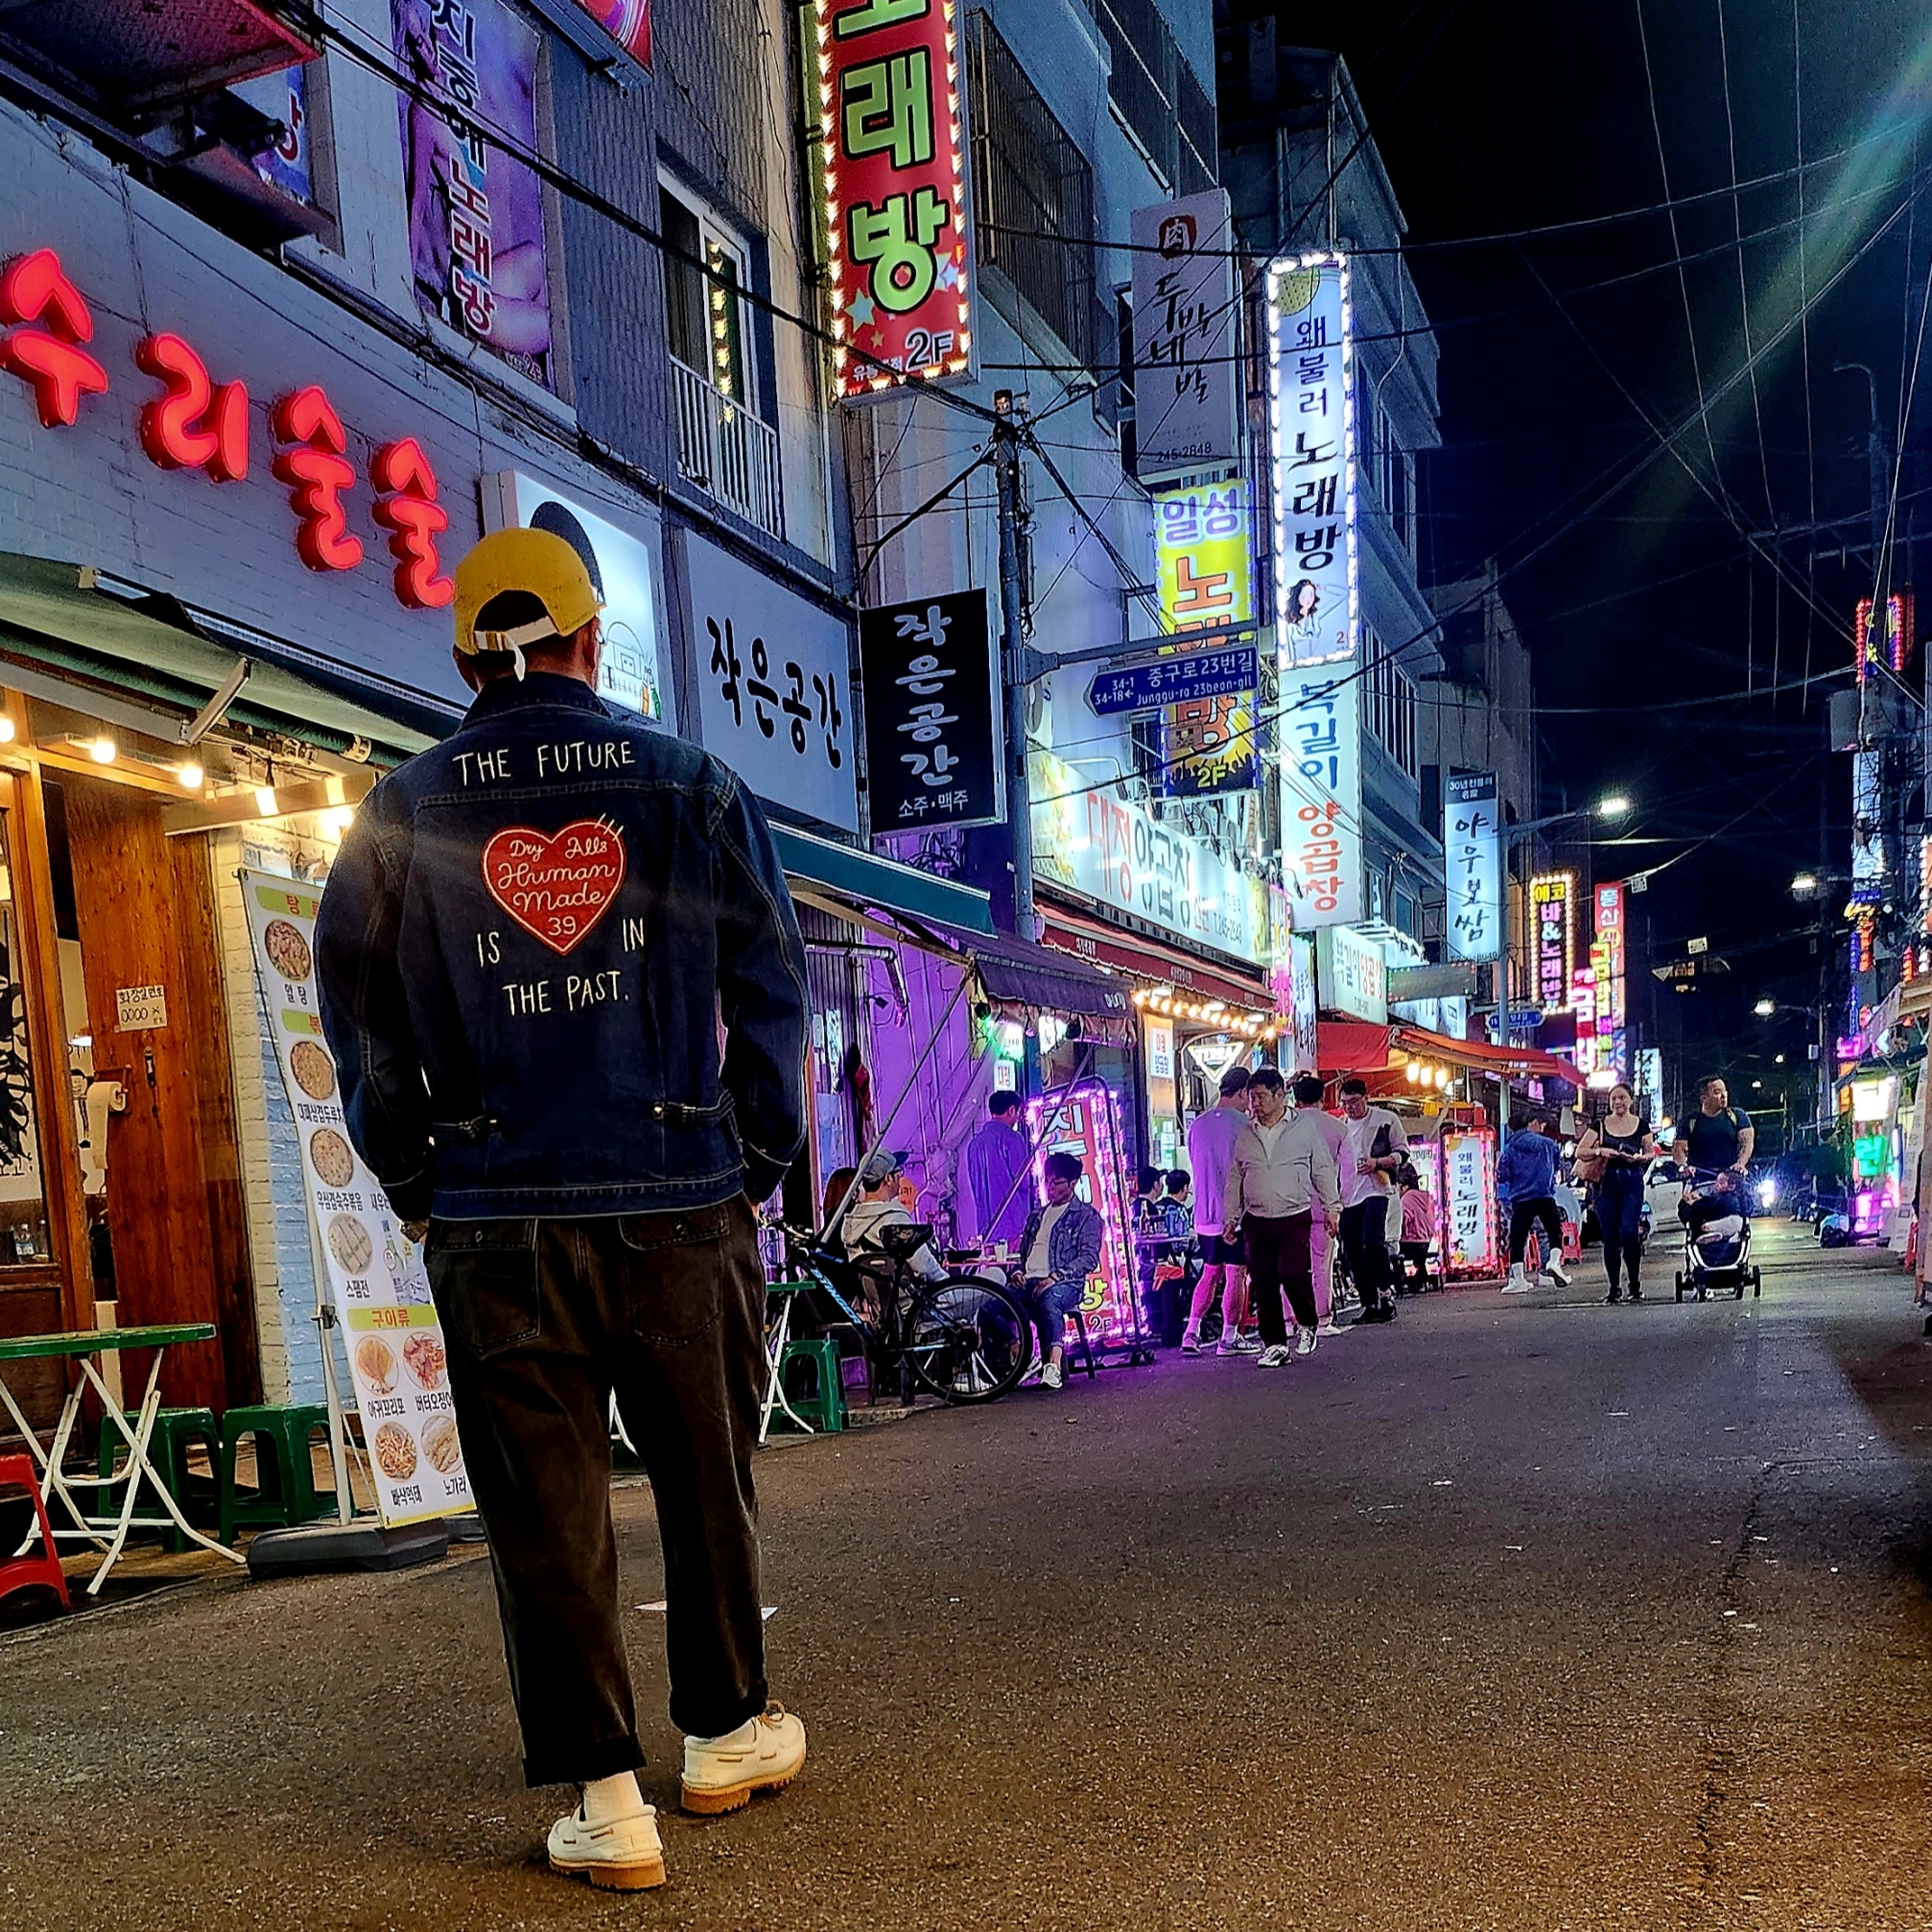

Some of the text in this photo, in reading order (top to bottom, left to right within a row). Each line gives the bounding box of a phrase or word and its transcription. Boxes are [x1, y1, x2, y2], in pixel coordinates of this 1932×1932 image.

[905, 327, 954, 372] 2F
[1295, 316, 1330, 417] 왜불러
[2, 247, 456, 610] 수리술술
[1164, 488, 1238, 542] 일성
[1287, 432, 1343, 571] 노래방
[1112, 676, 1135, 692] 34-1
[1136, 673, 1253, 707] Junggu-ro 23beon-gil
[1146, 650, 1254, 689] 중구로23번길
[706, 615, 842, 770] 작은공간
[894, 605, 959, 787] 작은공간
[1095, 690, 1124, 706] 34-18
[452, 741, 636, 786] THE FUTURE
[1197, 766, 1227, 789] 2F
[509, 836, 608, 862] Dry Alls
[1086, 792, 1132, 905] 대정
[1134, 818, 1190, 931] 양곱창
[1298, 799, 1345, 912] 양곱창
[497, 862, 616, 889] Human
[512, 882, 605, 913] Made
[1455, 813, 1491, 943] 야우보쌈
[476, 917, 645, 967] IS IN
[548, 915, 577, 936] 39
[502, 970, 629, 1016] THE PAST.
[1454, 1190, 1479, 1237] 노래방
[371, 1308, 411, 1329] 구이류
[442, 1475, 467, 1496] 노가리
